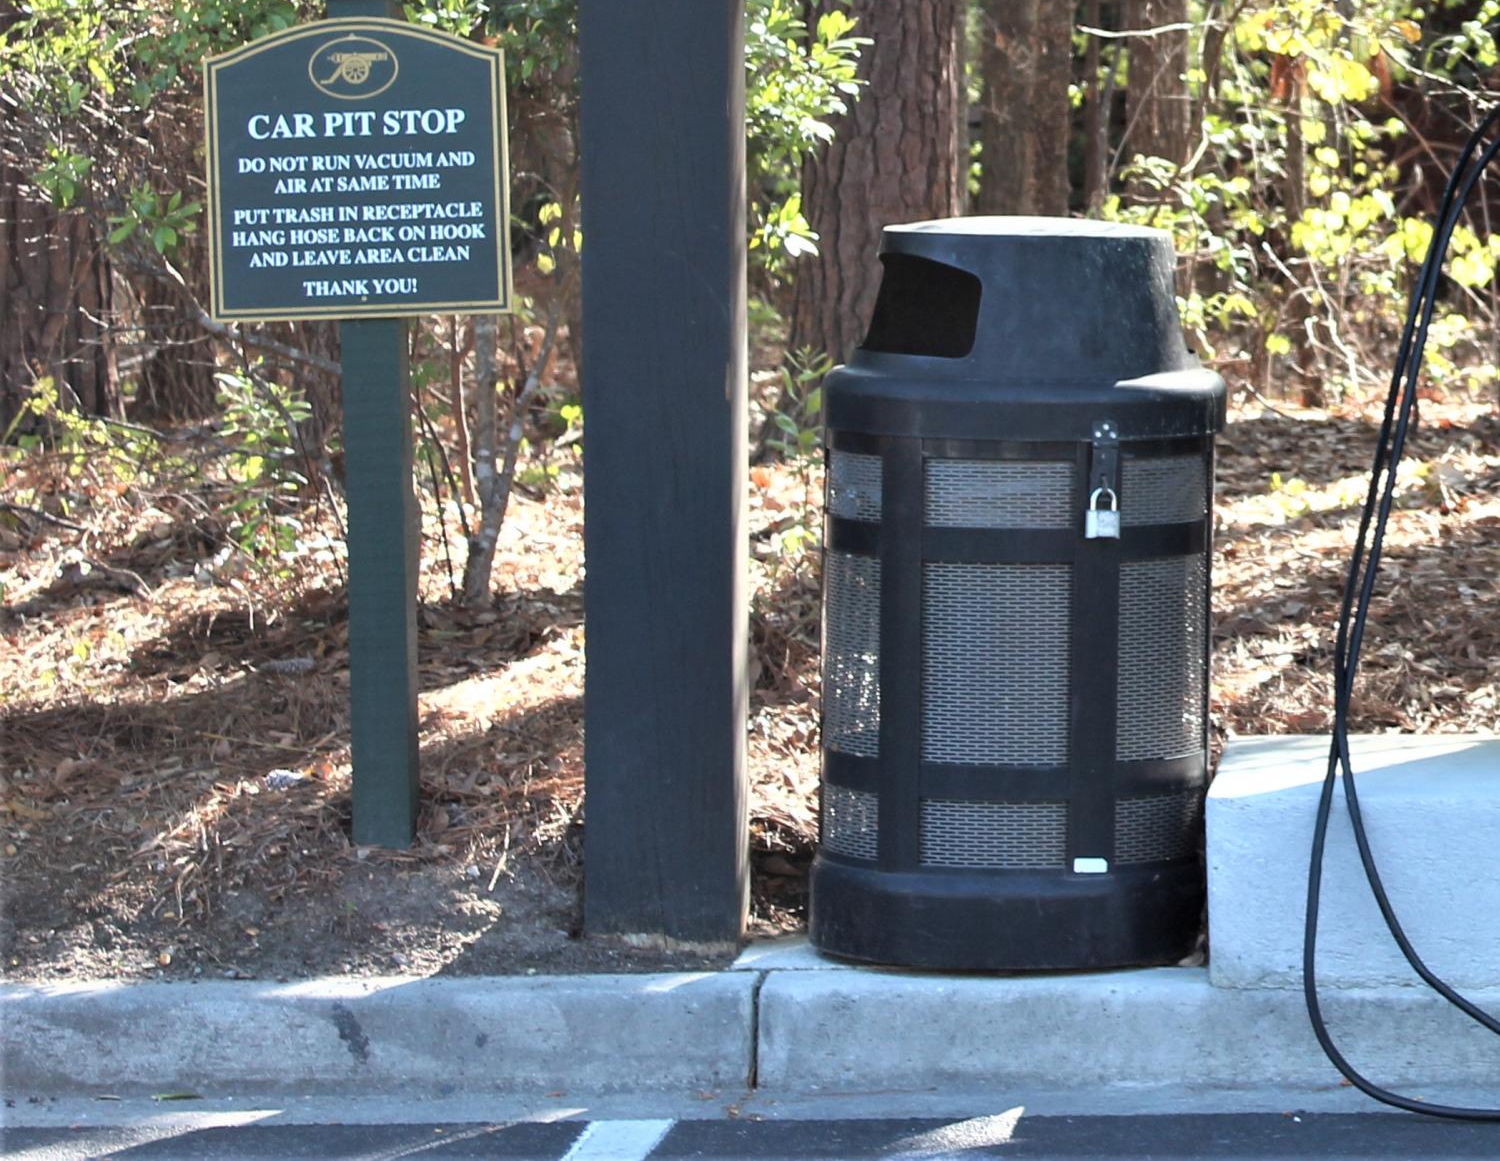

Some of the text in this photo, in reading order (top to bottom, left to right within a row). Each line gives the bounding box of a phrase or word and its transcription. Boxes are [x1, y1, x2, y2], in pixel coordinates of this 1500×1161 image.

[247, 108, 465, 139] CAR PIT STOP
[238, 150, 476, 174] DO NOT RUN VACUUM AND
[274, 173, 441, 195] AIR AT SAME TIME
[233, 201, 483, 225] PUT TRASH IN RECEPTACLE
[232, 223, 486, 247] HANG HOSE BACK ON HOOK
[249, 245, 470, 268] AND LEAVE AREA CLEAN
[303, 278, 418, 297] THANK YOU!
